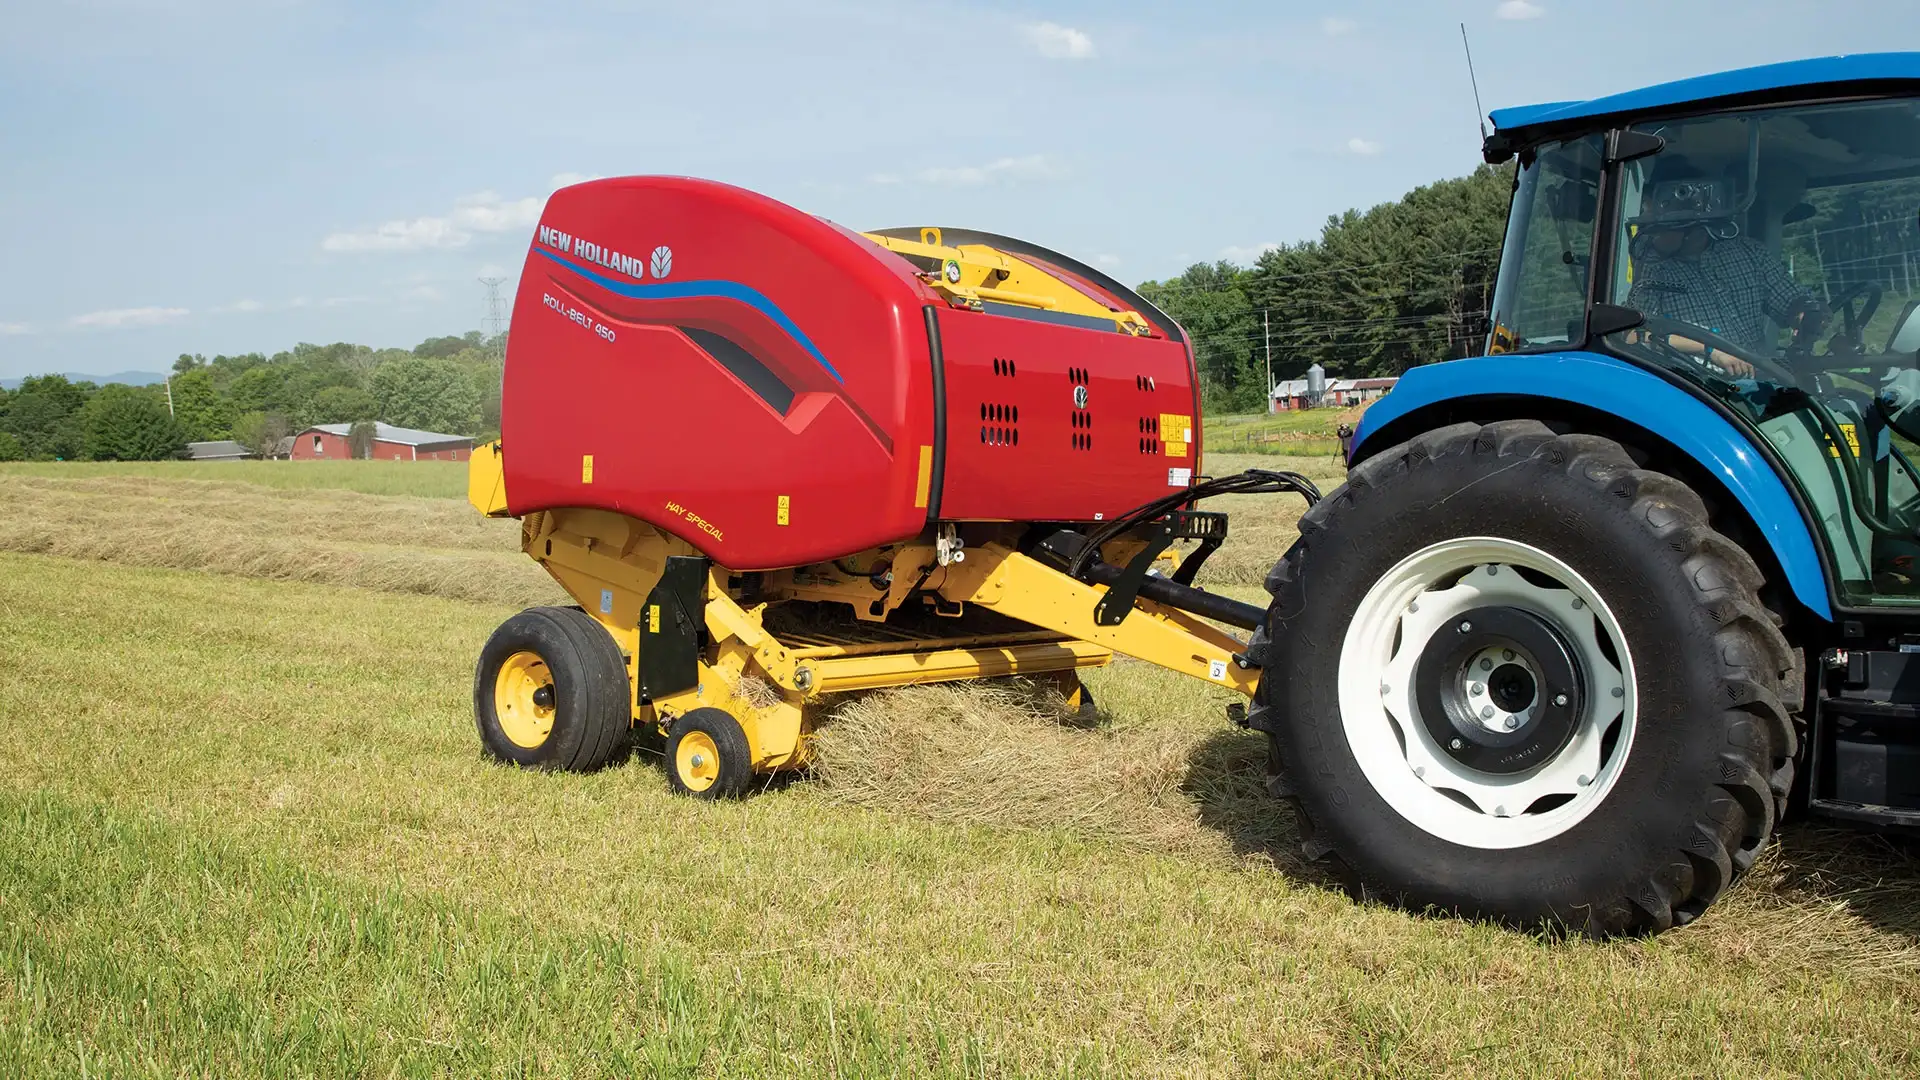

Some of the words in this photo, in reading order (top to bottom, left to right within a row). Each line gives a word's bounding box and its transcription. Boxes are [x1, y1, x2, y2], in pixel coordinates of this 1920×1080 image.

[539, 224, 572, 253] NEW
[574, 238, 644, 279] HOLLAND
[543, 293, 593, 329] ROLL-BELT
[595, 323, 617, 343] 450
[665, 501, 687, 516] HAY
[685, 512, 723, 542] SPECIAL
